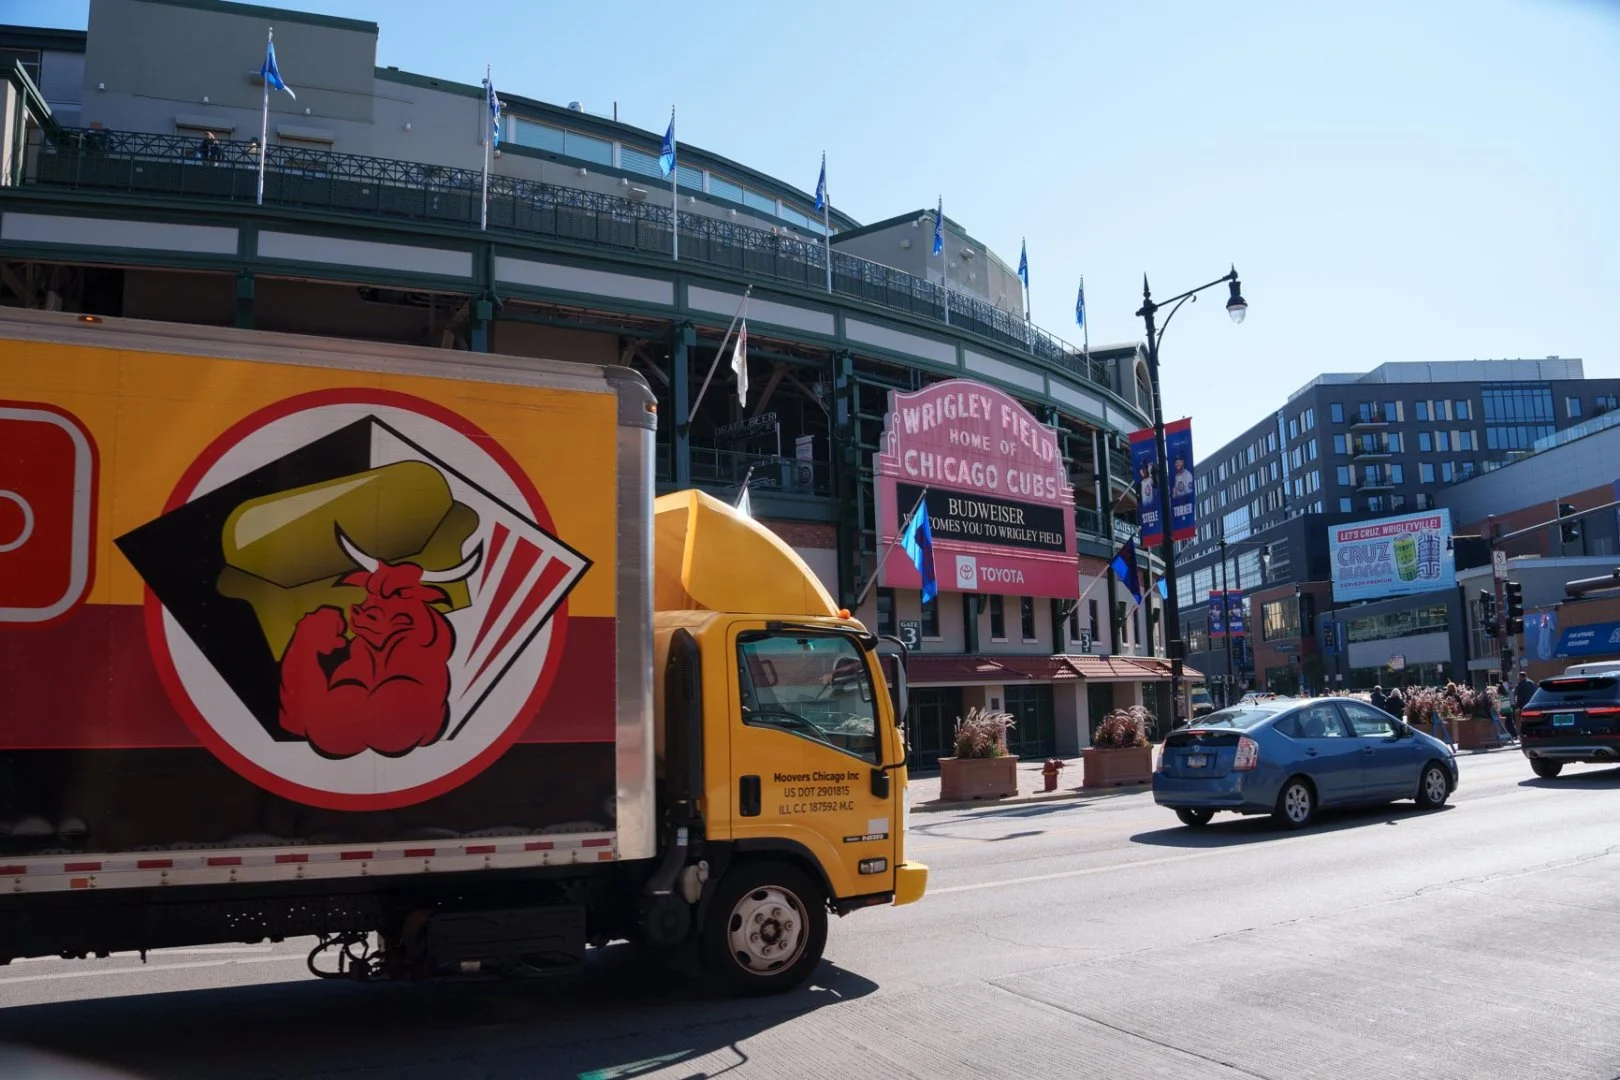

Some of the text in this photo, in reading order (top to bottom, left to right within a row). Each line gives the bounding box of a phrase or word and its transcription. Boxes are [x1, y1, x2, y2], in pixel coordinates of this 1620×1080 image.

[903, 392, 1054, 464] WRIGLEY FIELD
[950, 428, 1017, 457] HOME OF
[904, 448, 1057, 499] CHICAGO CUBS
[948, 498, 1025, 525] BUDWEISER
[962, 521, 982, 535] YOU
[984, 524, 997, 537] TO
[999, 526, 1038, 543] WRIGLEY
[1039, 532, 1063, 545] FIELD
[1382, 519, 1438, 535] WRIGLEYVILLE!
[1338, 542, 1391, 566] CRUZ
[980, 566, 1025, 584] TOYOTA
[904, 628, 917, 645] 3
[1082, 634, 1090, 648] 3
[774, 770, 860, 784] Moovers Chicago Inc
[784, 786, 850, 798] US DOT 2901815
[809, 801, 838, 813] 187592
